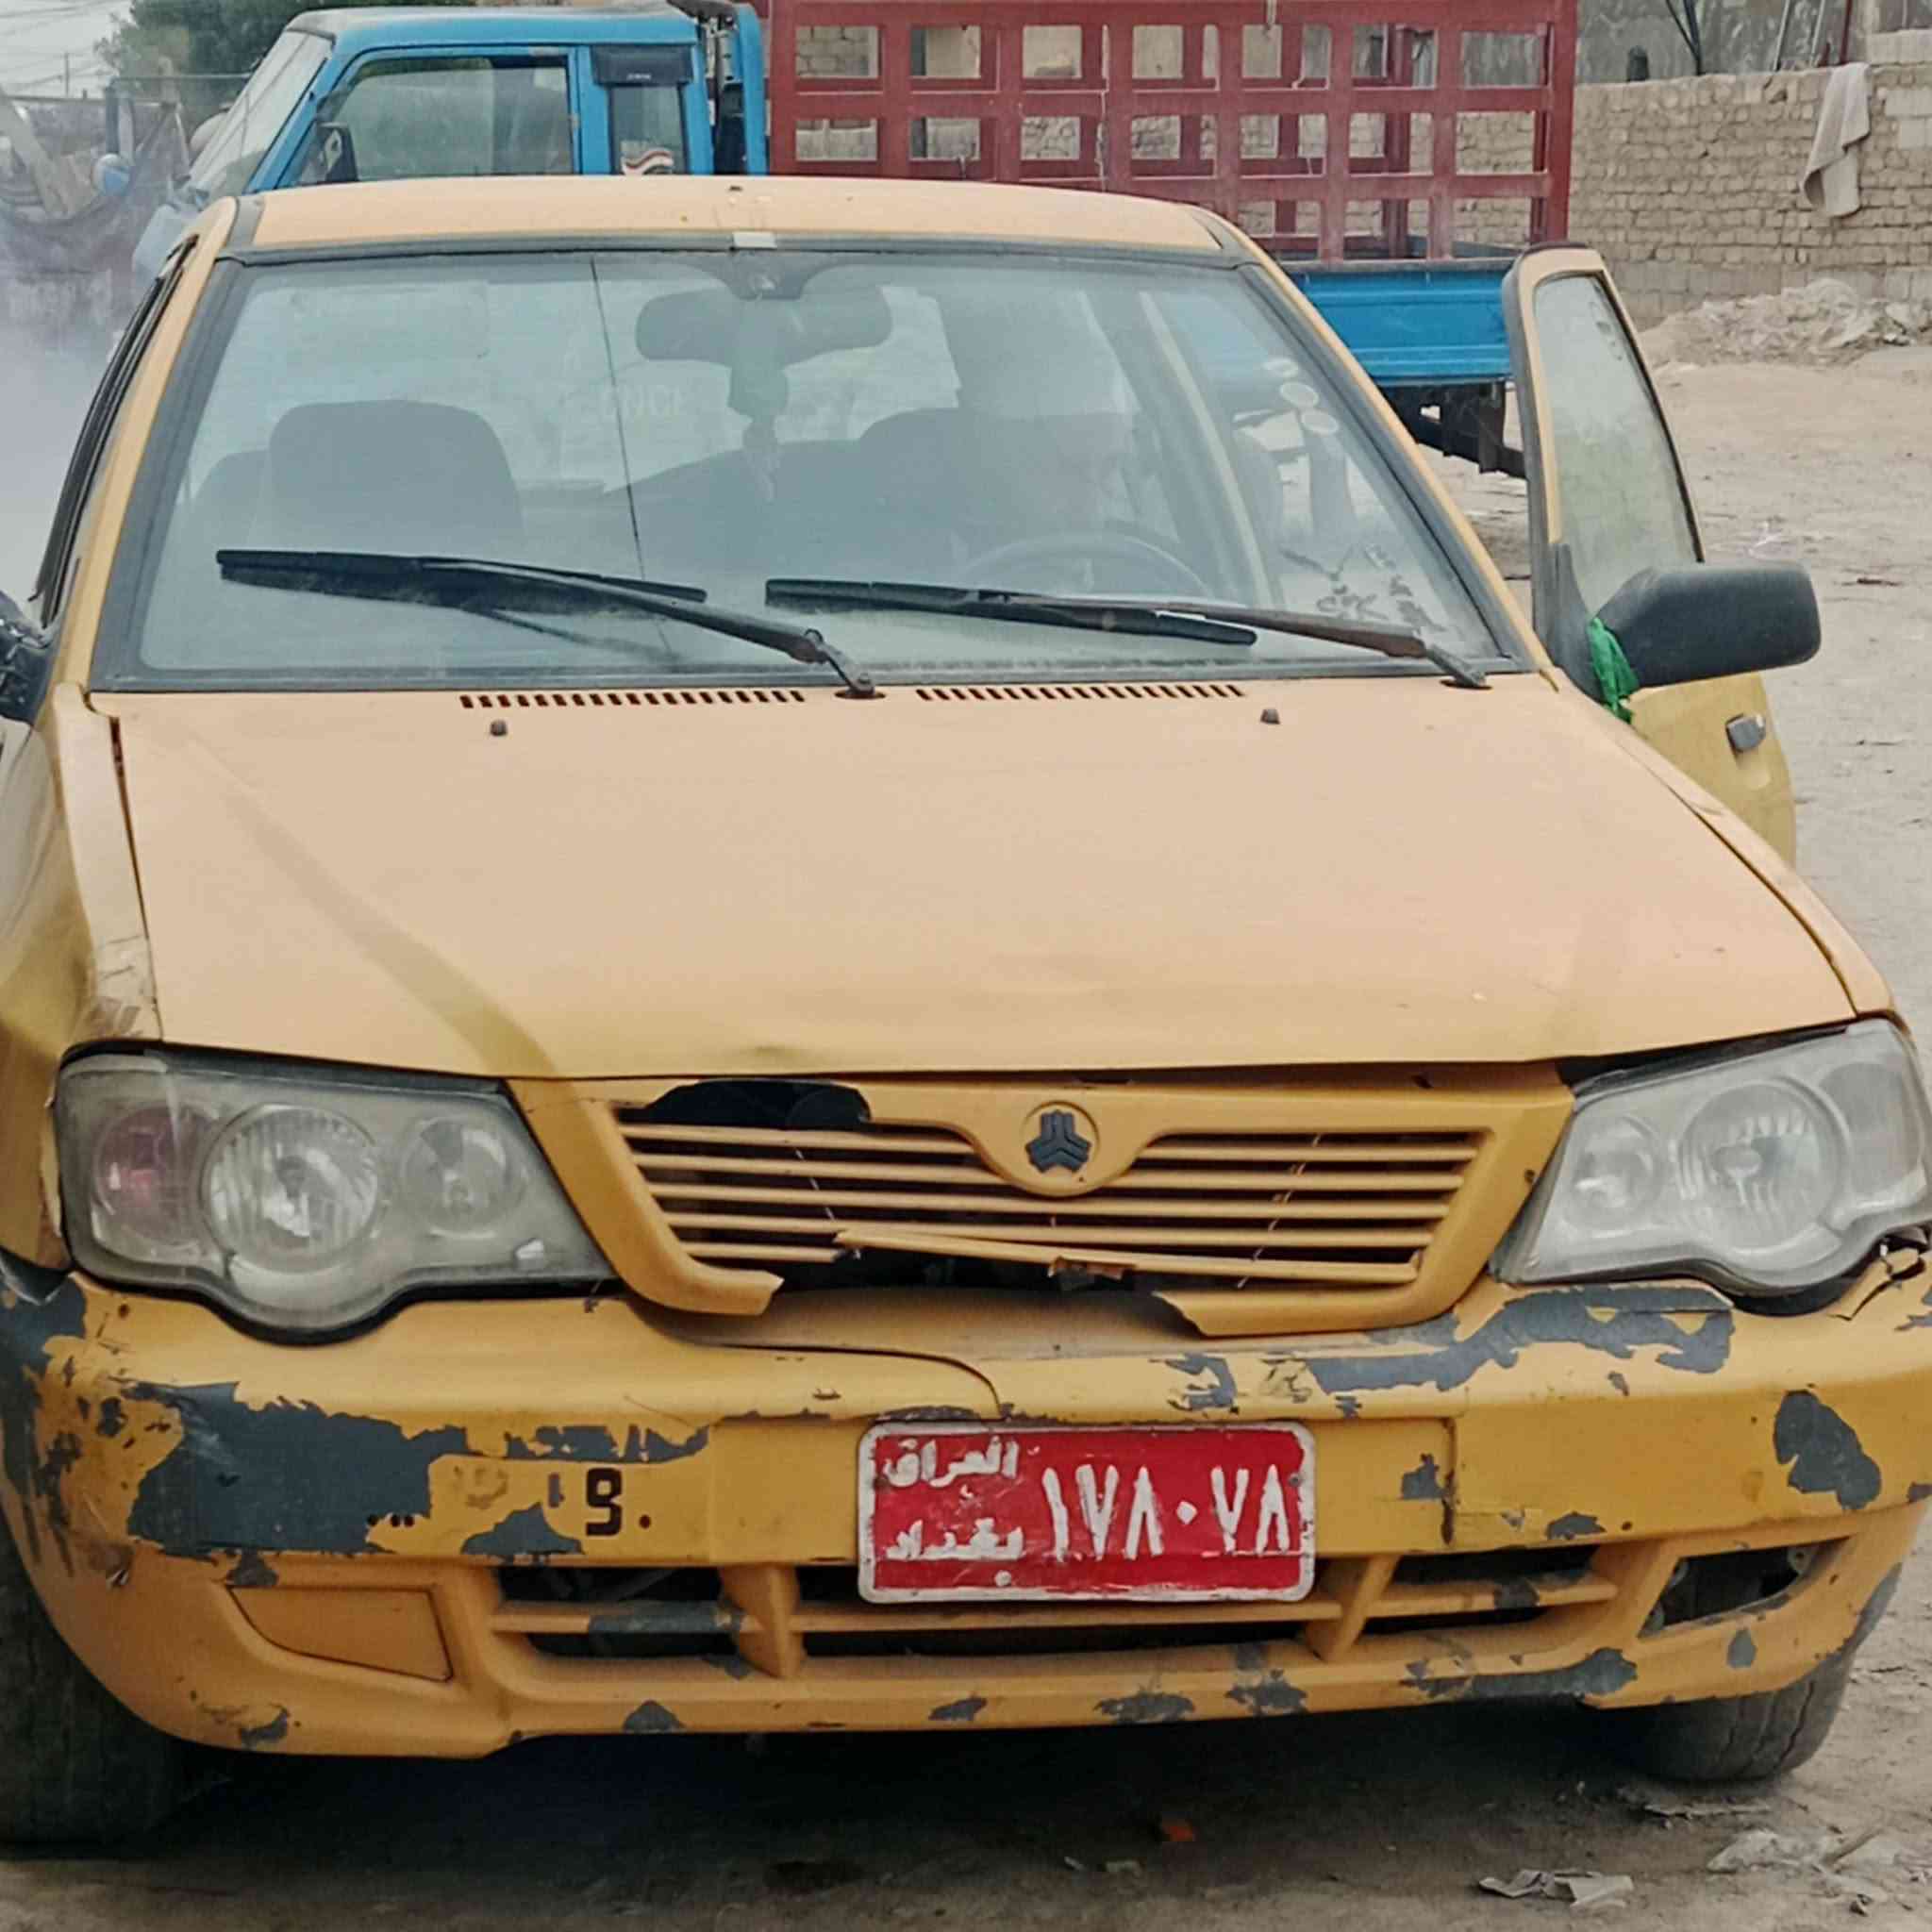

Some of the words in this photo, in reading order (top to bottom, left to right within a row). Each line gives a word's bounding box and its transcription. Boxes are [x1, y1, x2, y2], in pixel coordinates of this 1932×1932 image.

[884, 1435, 1020, 1488] العراق
[1042, 1464, 1291, 1562] ١٧٨٠٧٨
[887, 1517, 1024, 1586] بغداد
